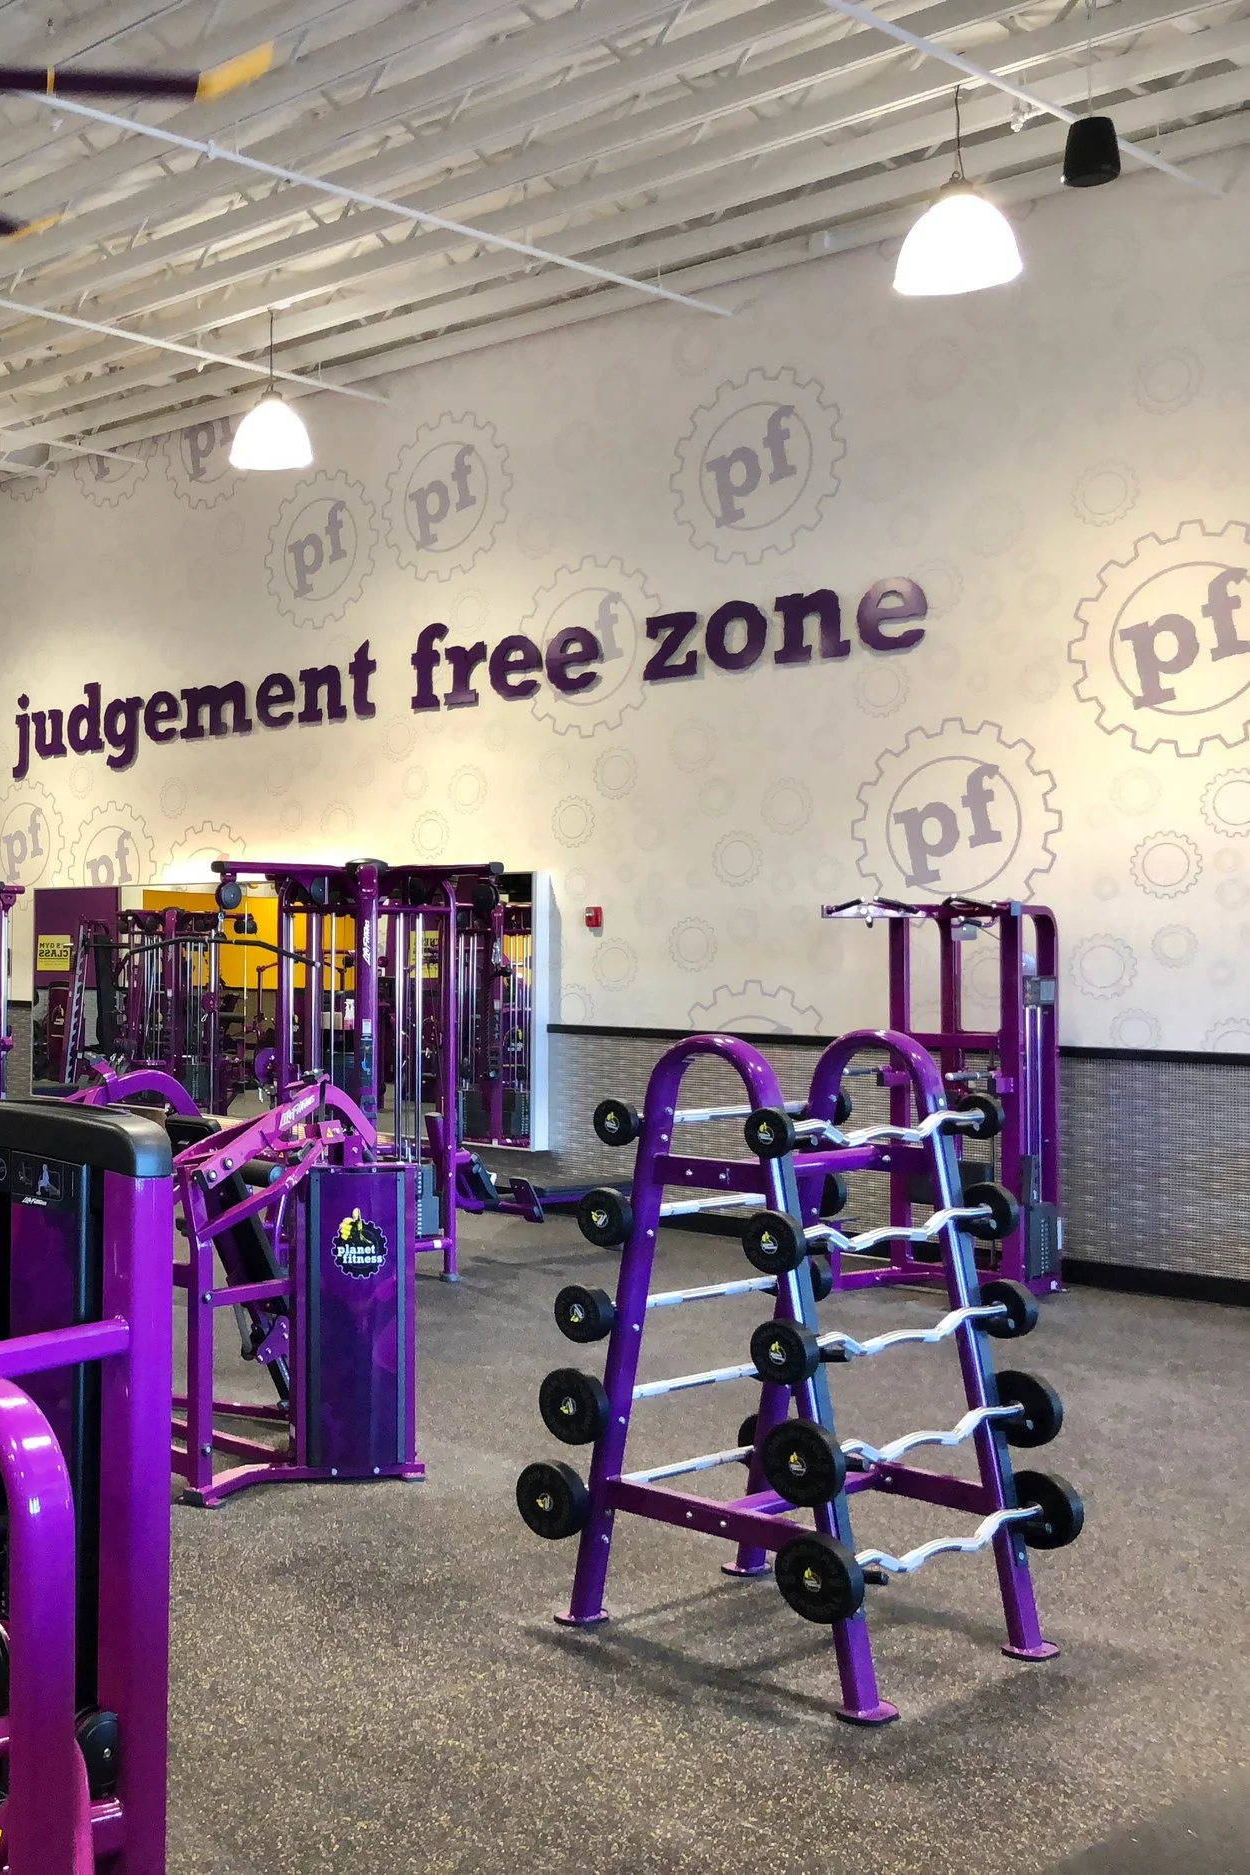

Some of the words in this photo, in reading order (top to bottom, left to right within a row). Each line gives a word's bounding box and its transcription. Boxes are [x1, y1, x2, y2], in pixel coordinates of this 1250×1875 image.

[409, 444, 477, 551] pf
[706, 404, 797, 528] pf
[287, 500, 347, 599] pf
[12, 638, 378, 779] judgement
[410, 622, 600, 710] free
[643, 576, 929, 682] zone
[1119, 567, 1250, 711] pf
[2, 807, 44, 883] pf
[86, 830, 133, 885] pf
[893, 763, 1003, 889] pf
[336, 1244, 376, 1257] planet
[342, 1253, 383, 1264] fitness
